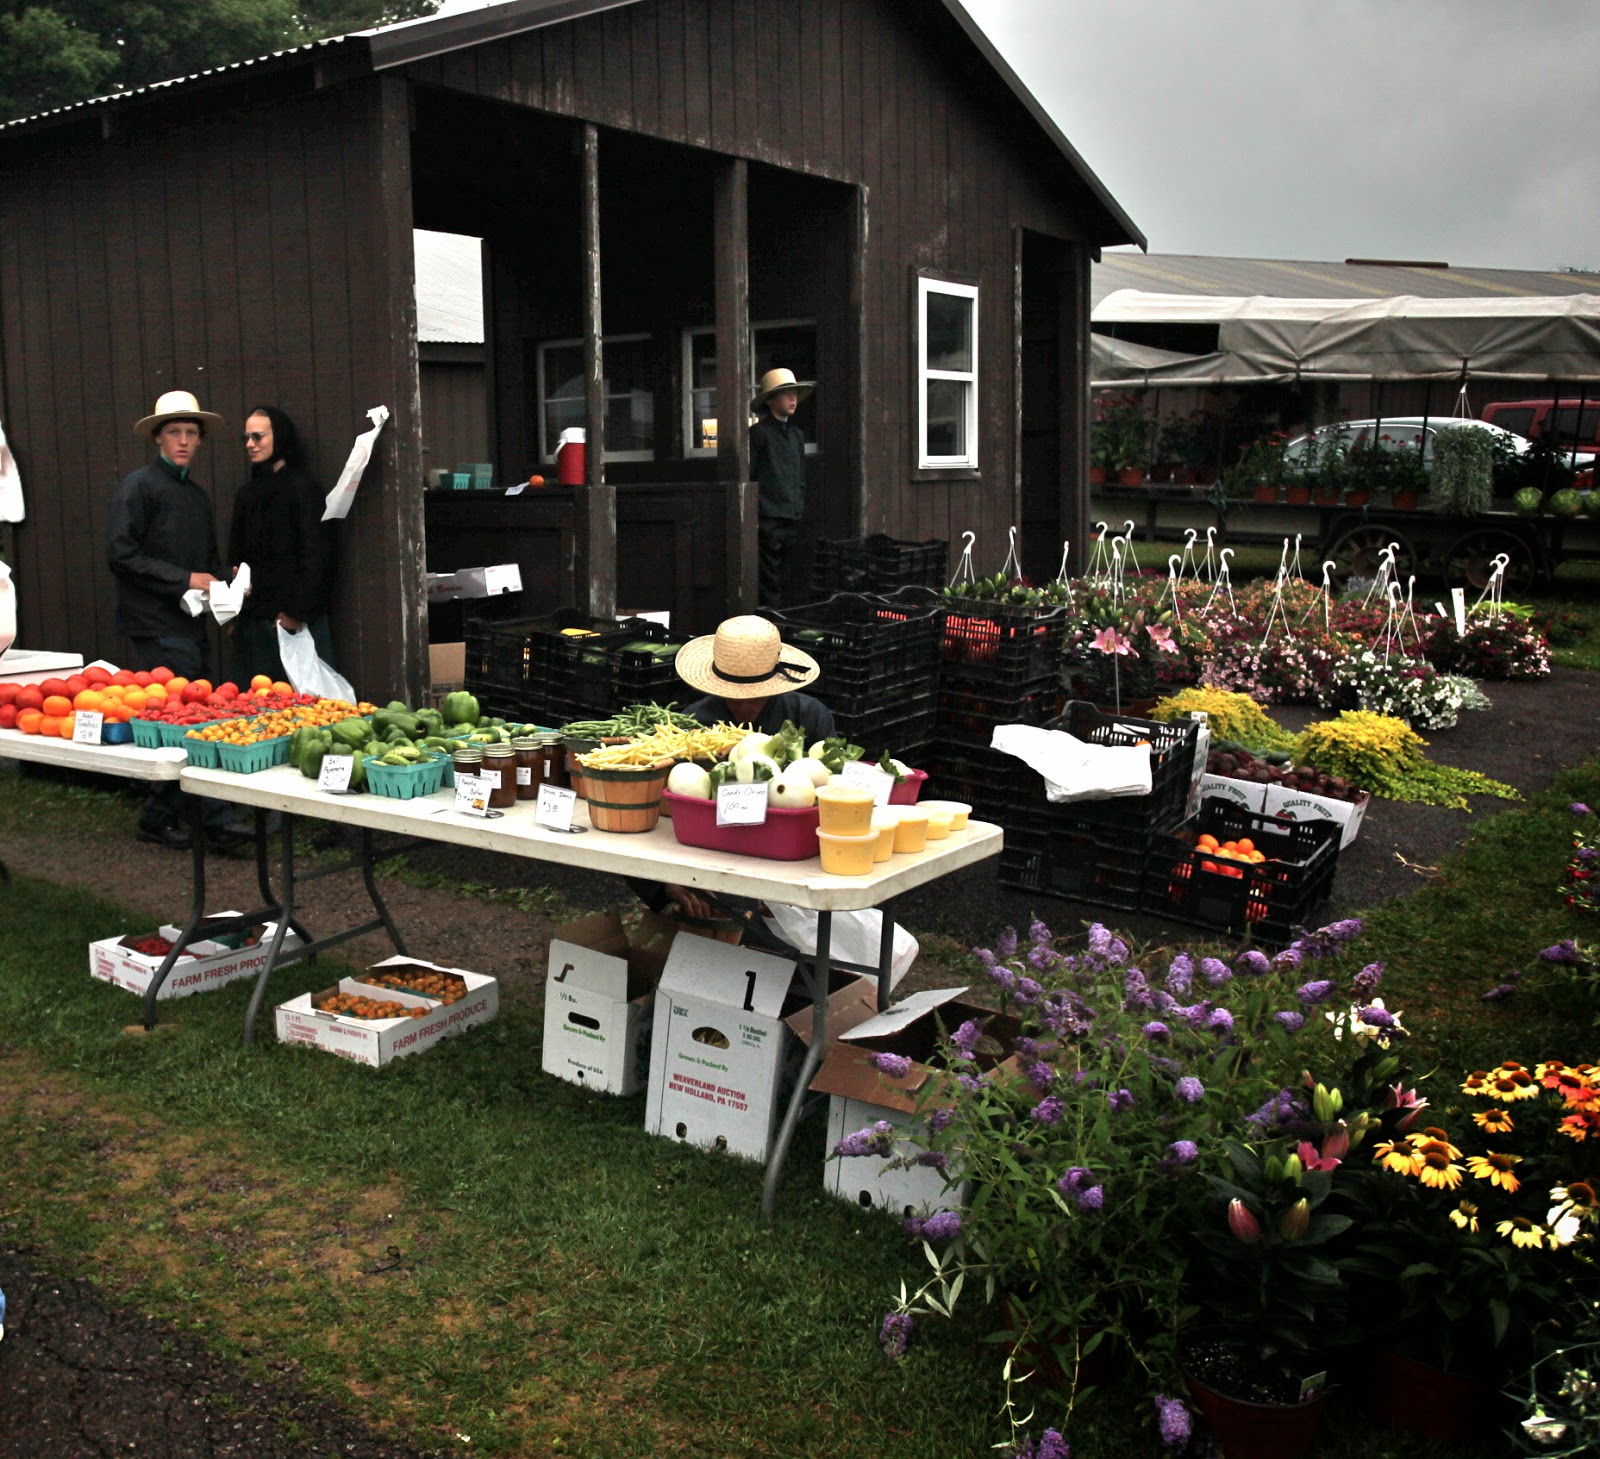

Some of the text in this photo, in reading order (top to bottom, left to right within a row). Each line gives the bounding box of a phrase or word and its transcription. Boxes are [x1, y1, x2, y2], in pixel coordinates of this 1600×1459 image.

[1228, 785, 1247, 800] FRUIT
[1282, 799, 1333, 819] QUALITY FRUIT
[171, 971, 202, 989] FARM
[204, 961, 238, 981] FRESH
[393, 999, 488, 1053] FARM FRESH PRODUCE
[701, 1059, 721, 1070] Packed
[668, 1081, 748, 1112] NEW HOLLAND, PA 17557
[673, 1073, 746, 1101] WEAVERLAND AUCTION
